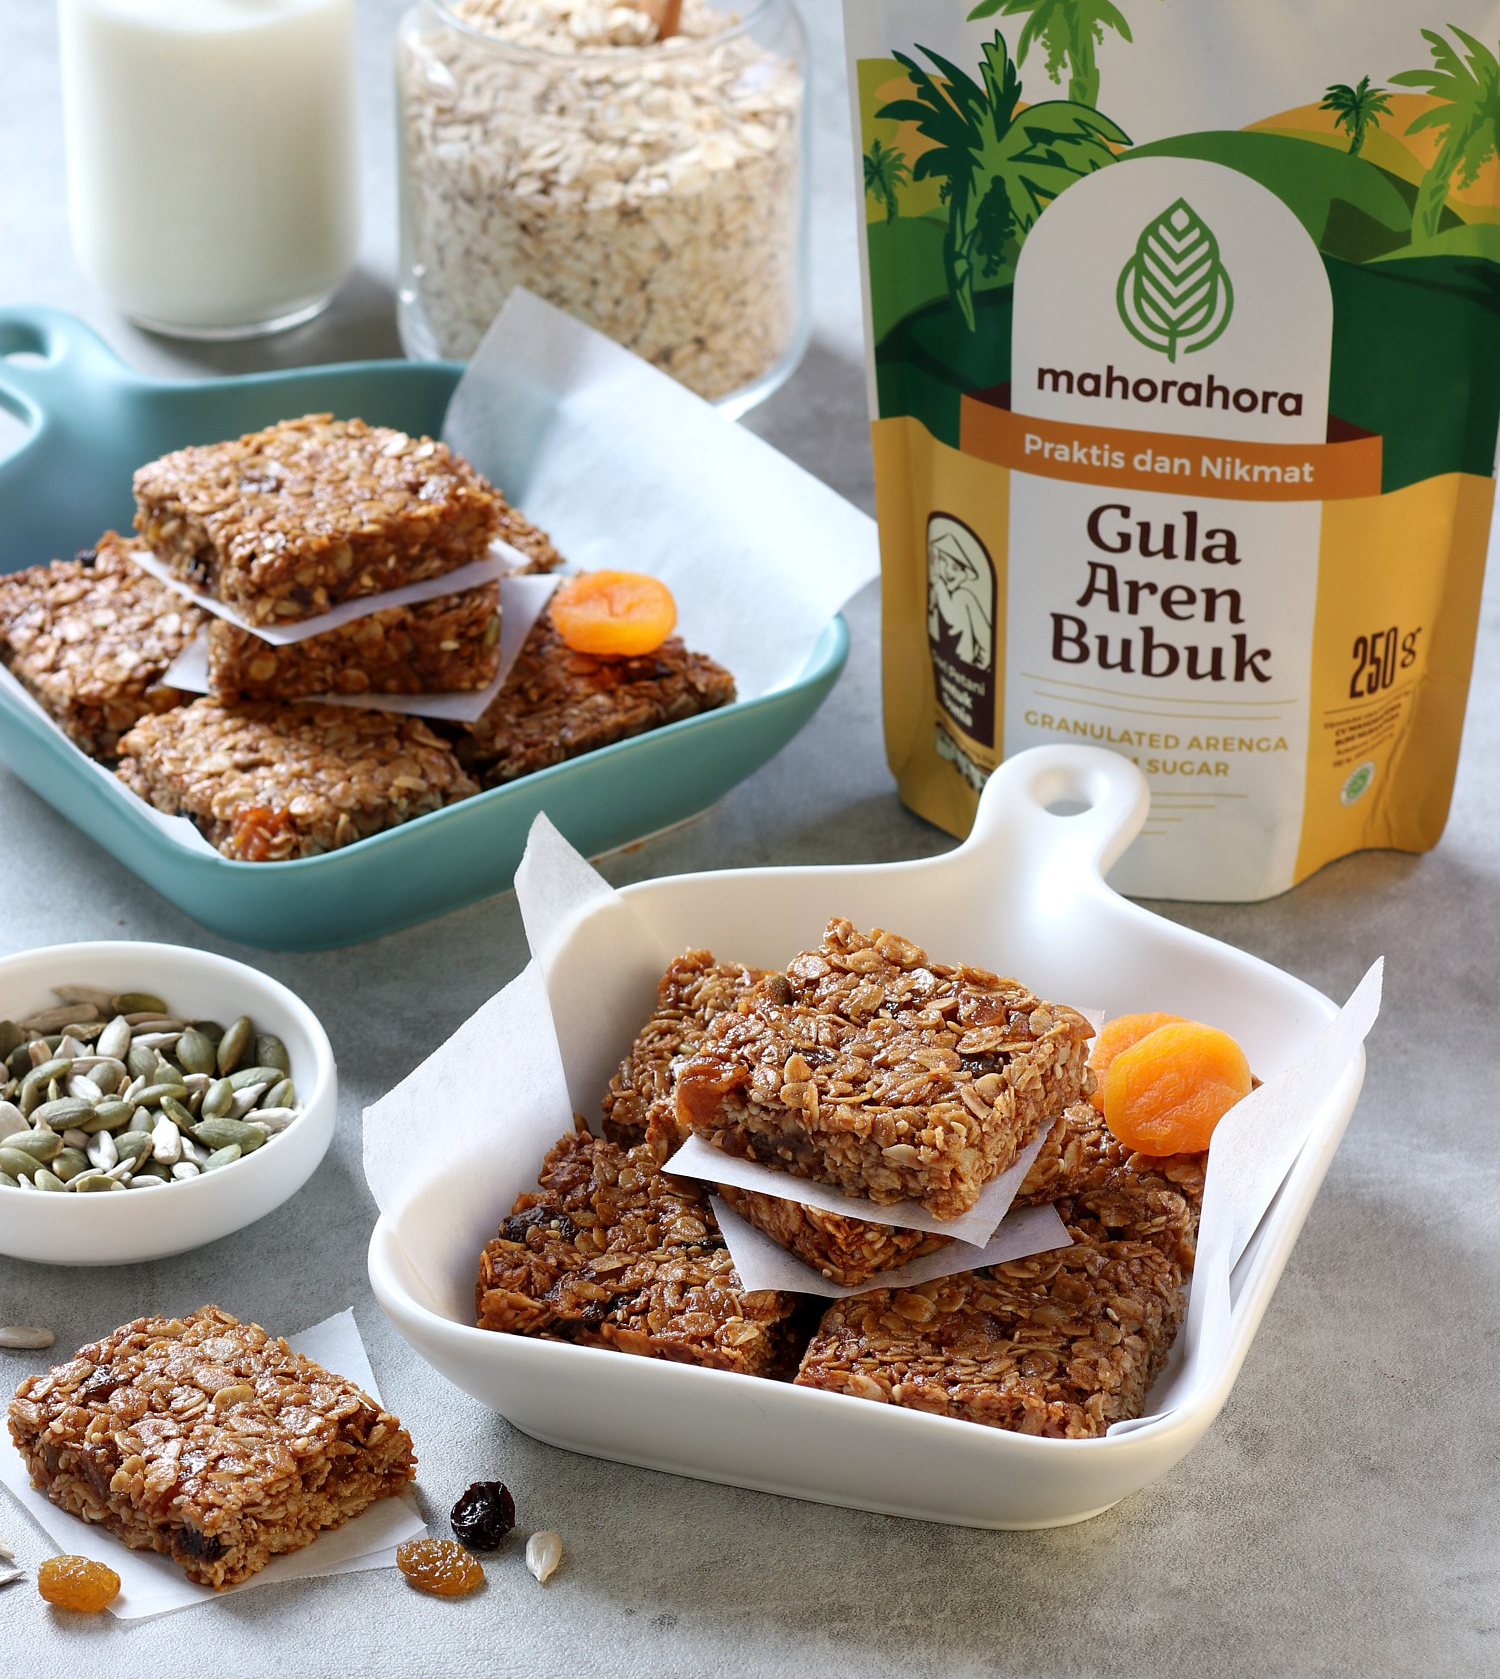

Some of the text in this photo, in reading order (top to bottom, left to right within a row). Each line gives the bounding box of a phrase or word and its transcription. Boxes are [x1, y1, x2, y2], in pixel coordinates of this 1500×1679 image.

[1037, 365, 1303, 416] mahorahora
[1024, 433, 1315, 483] Praktis dan Nikmat
[1086, 503, 1242, 565] Gula
[1075, 560, 1246, 624] Aren
[1050, 612, 1272, 683] Bubuk
[1024, 710, 1289, 752] GRANULATED ARENGA
[1146, 758, 1230, 777] SUGAR
